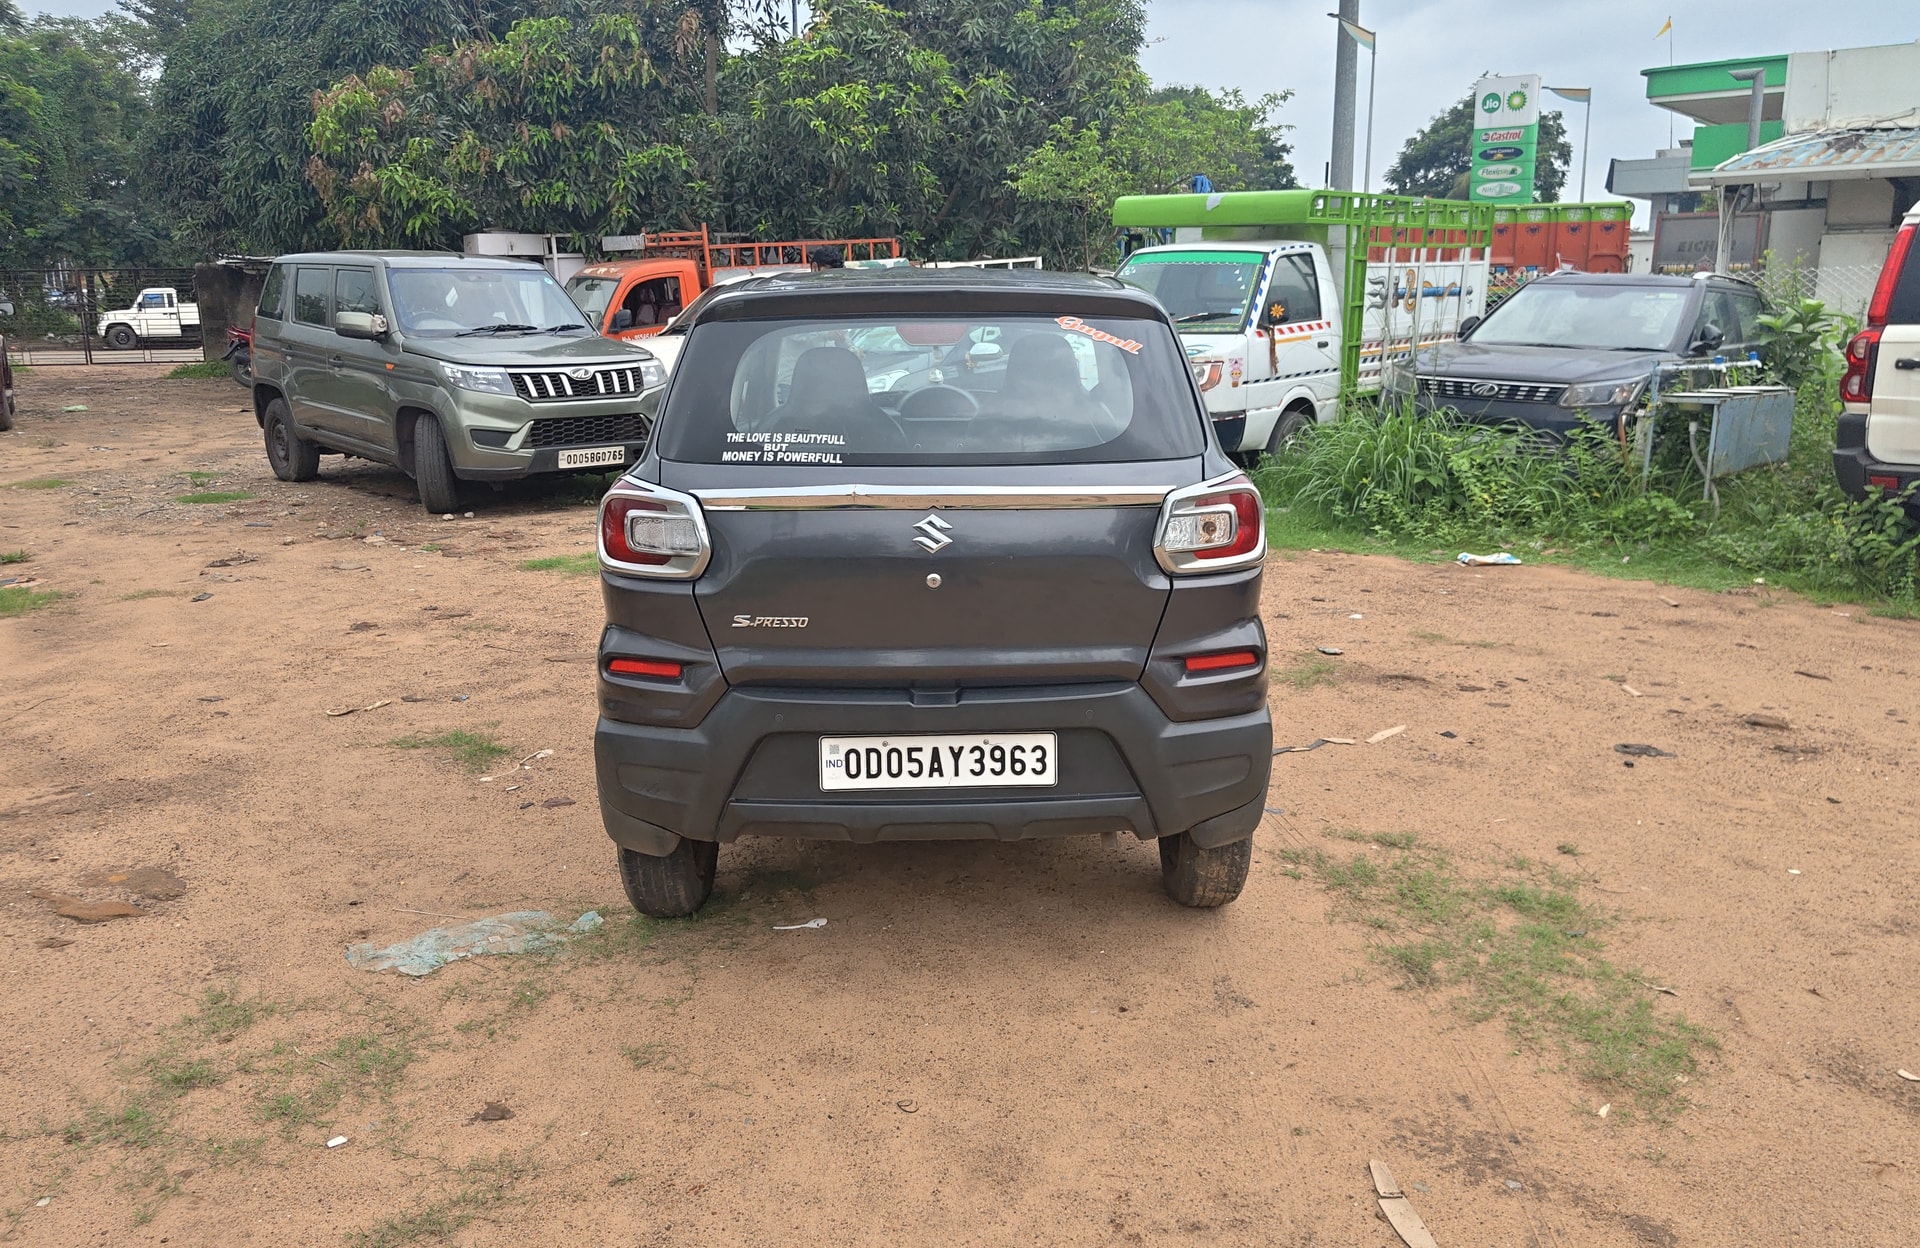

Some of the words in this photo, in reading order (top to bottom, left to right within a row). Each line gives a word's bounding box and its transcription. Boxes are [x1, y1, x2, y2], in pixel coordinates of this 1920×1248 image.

[1483, 98, 1500, 110] Jio
[1490, 130, 1522, 142] Castrol
[726, 433, 745, 443] THE
[746, 433, 772, 443] LOVE
[772, 433, 783, 443] IS
[784, 433, 846, 445] BEAUTYFULL
[763, 443, 789, 452] BUT
[566, 450, 623, 465] OD05BG0765
[722, 451, 762, 462] MONEY
[763, 451, 775, 462] IS
[776, 452, 843, 464] POWERFULL
[731, 614, 809, 628] S-PRESSO
[825, 759, 843, 768] IND
[844, 745, 1047, 779] OD05AY3963
